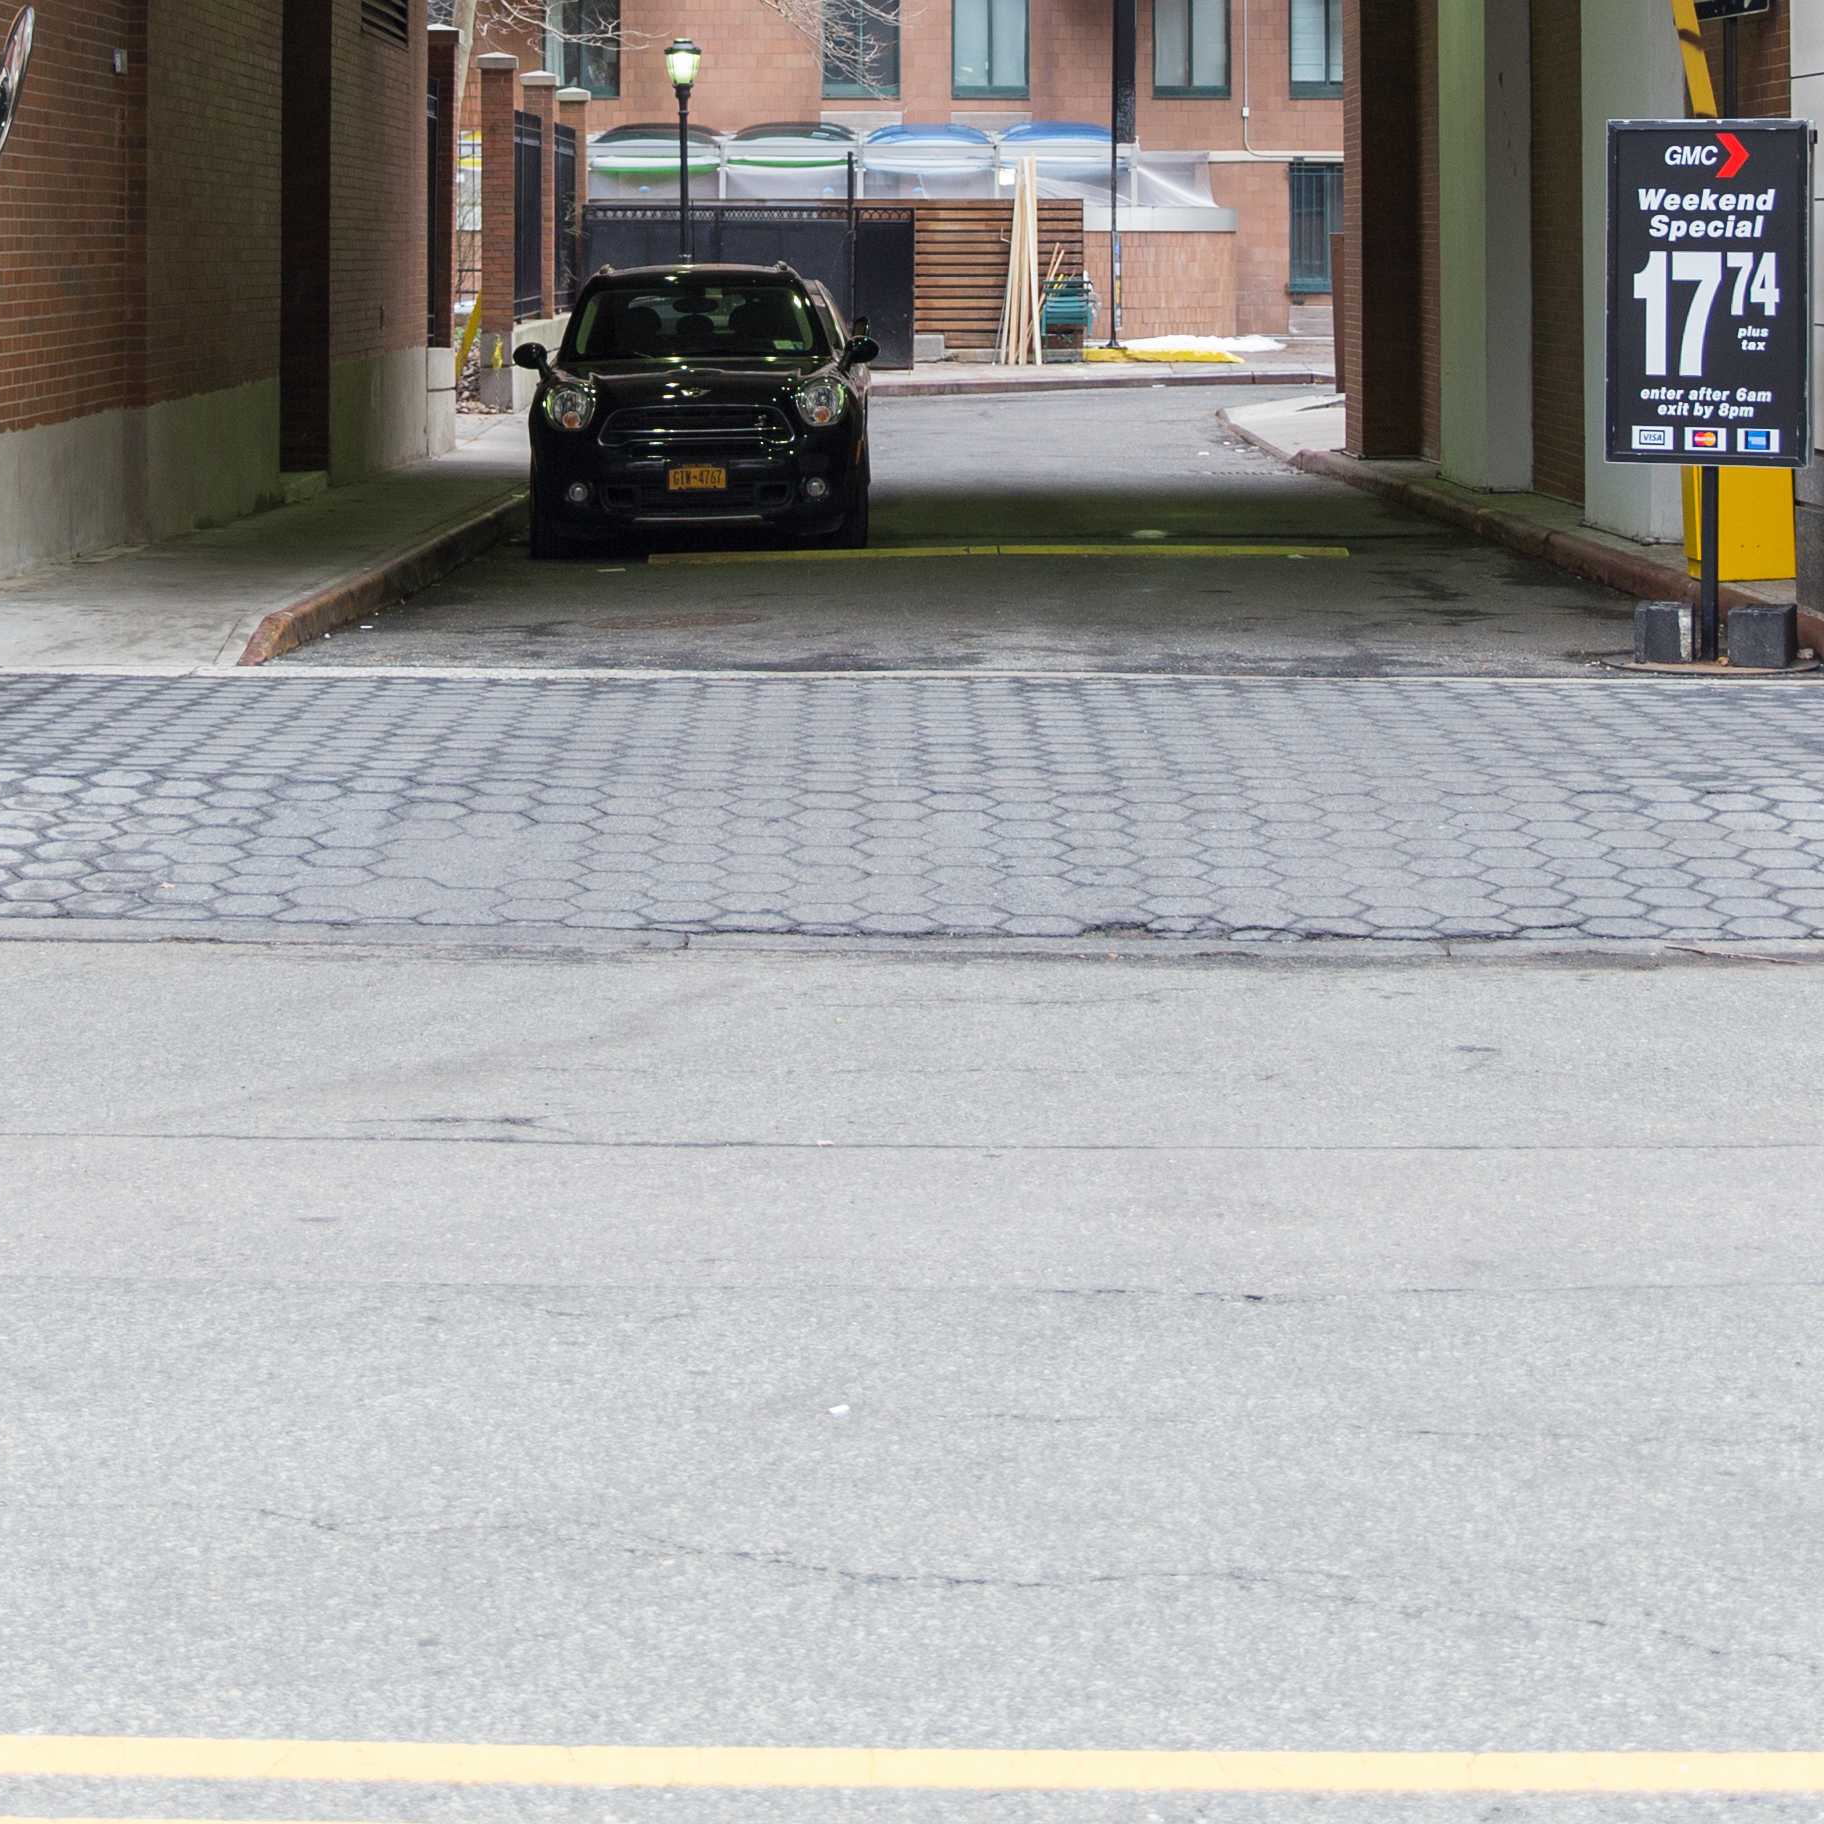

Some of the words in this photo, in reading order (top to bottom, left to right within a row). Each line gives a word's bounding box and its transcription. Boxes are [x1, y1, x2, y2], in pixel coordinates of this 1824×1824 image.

[1664, 145, 1719, 166] GMC
[1637, 188, 1776, 212] Weekend
[1648, 214, 1765, 242] Special
[1737, 325, 1769, 339] plus
[1741, 339, 1766, 351] tax
[1640, 386, 1684, 401] enter
[1688, 386, 1731, 402] after
[1735, 387, 1773, 403] 6am
[1657, 402, 1690, 416] exit
[1693, 402, 1714, 419] by
[1718, 402, 1755, 419] 8pm
[1642, 433, 1663, 442] VISA
